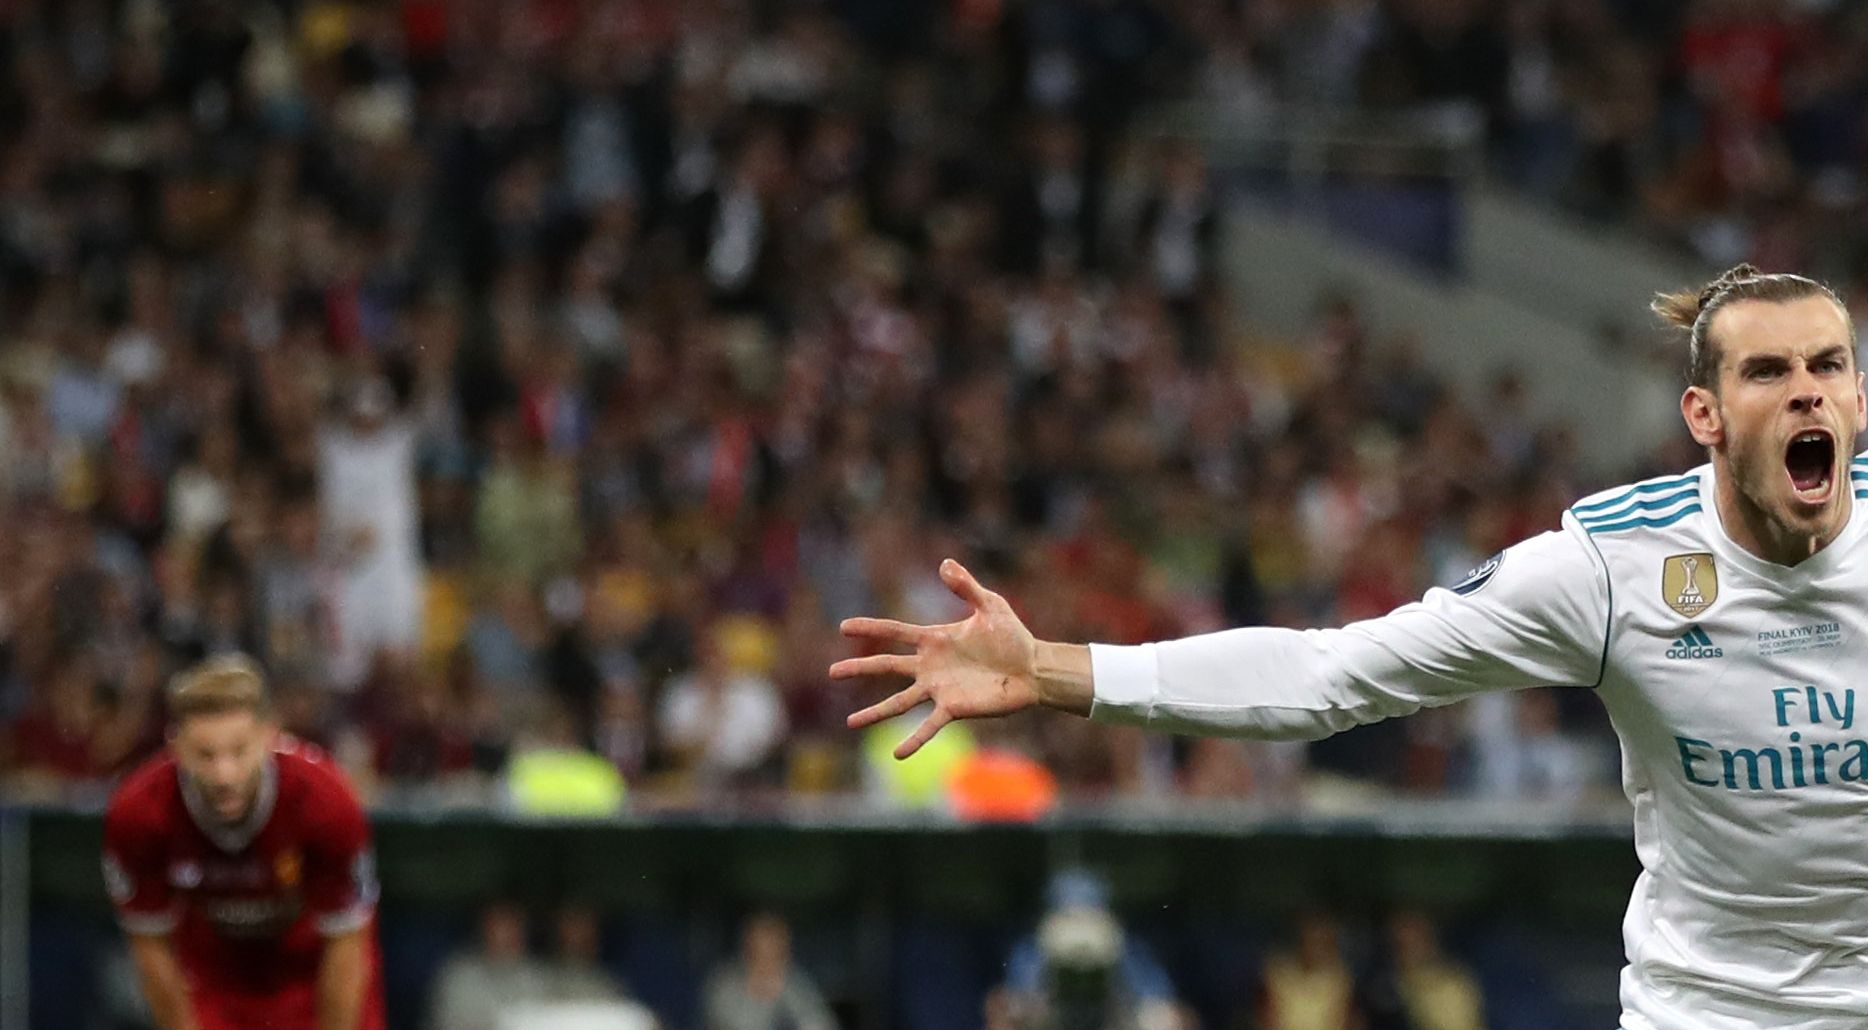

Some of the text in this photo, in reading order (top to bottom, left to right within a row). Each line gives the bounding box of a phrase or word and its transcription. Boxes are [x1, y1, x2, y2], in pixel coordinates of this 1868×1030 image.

[1677, 595, 1704, 604] FIFA
[1758, 630, 1788, 641] FINAL
[1790, 626, 1813, 638] KYIV
[1816, 623, 1840, 634] 2018
[1665, 646, 1724, 660] adidas
[1772, 686, 1855, 730] Fly
